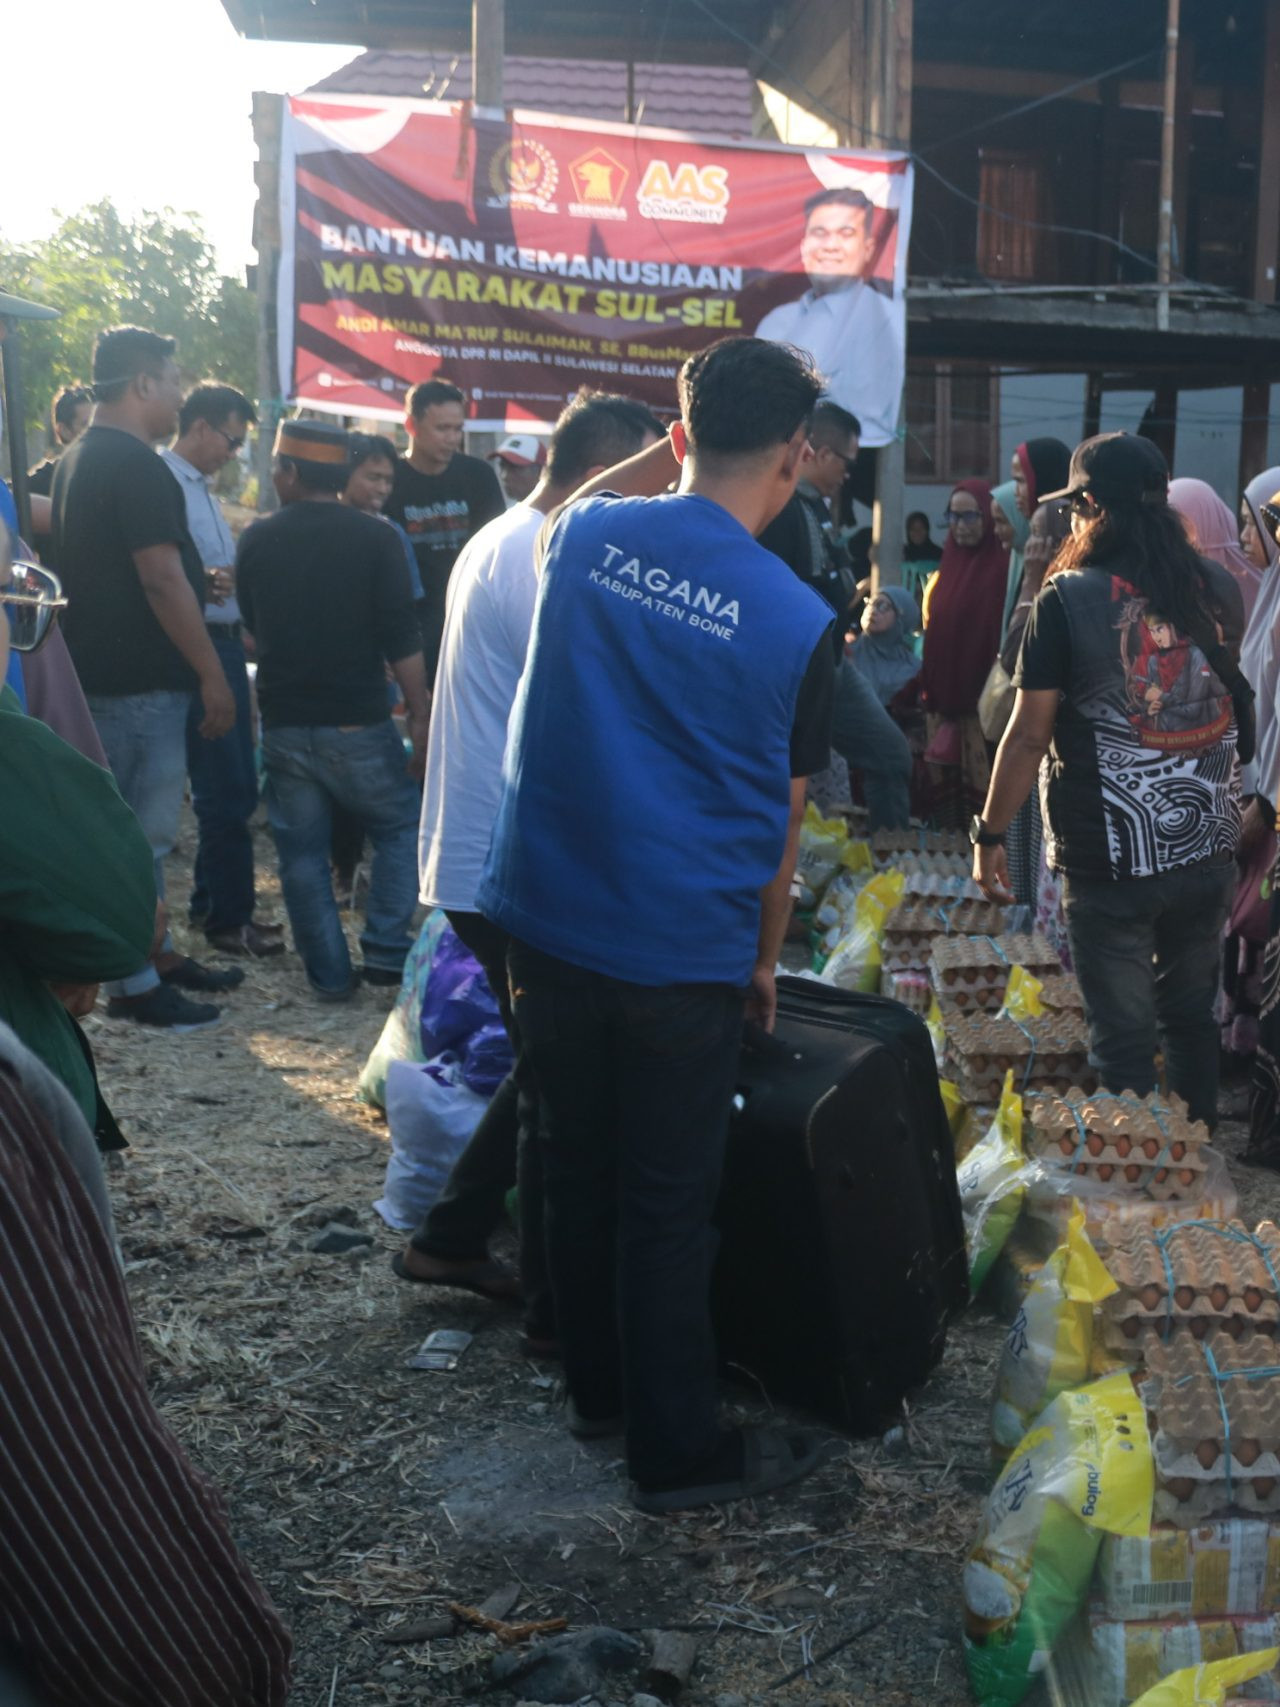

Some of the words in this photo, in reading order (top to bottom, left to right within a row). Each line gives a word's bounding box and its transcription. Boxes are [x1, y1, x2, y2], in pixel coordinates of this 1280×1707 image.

[642, 162, 727, 206] AAS
[642, 204, 723, 220] COMMUNITY
[320, 224, 486, 264] BANTUAN
[495, 243, 743, 291] KEMANUSIAAN
[320, 260, 586, 315] MASYARAKAT
[595, 289, 743, 329] SUL-SEL
[336, 315, 379, 332] ANDI
[381, 318, 431, 337] AMAR
[394, 339, 459, 360] ANGGOTA
[460, 347, 487, 361] DPR
[488, 348, 502, 361] RI
[503, 349, 542, 364] DAPIL
[554, 355, 619, 373] SULAWESI
[621, 362, 677, 379] SELATAN
[588, 568, 686, 622] KABUPATEN
[687, 613, 735, 641] BONE
[602, 543, 740, 626] TAGANA
[1081, 1471, 1102, 1517] bulog
